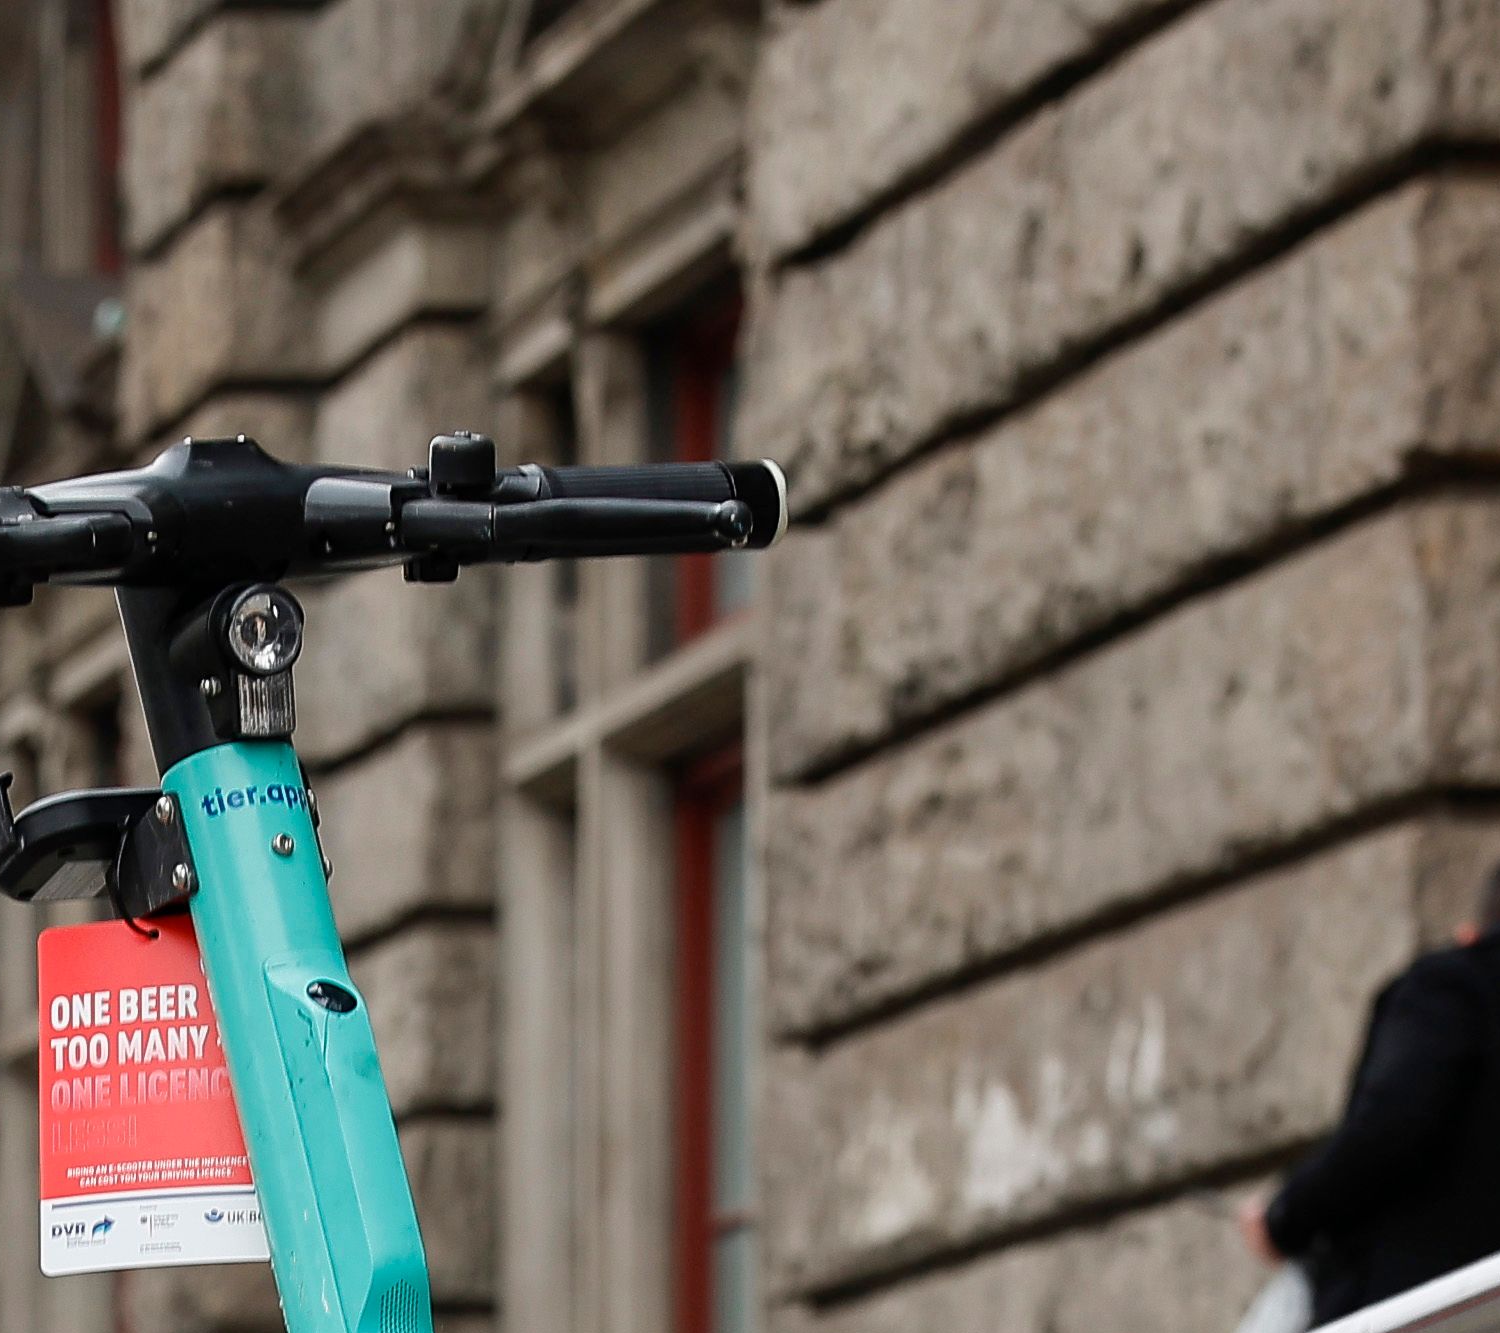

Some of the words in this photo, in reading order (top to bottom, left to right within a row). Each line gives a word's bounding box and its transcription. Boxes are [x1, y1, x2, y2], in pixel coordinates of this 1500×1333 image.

[201, 783, 307, 816] tier.app
[50, 991, 111, 1031] ONE
[119, 984, 199, 1024] BEER
[50, 1032, 110, 1072] TOO
[118, 1025, 209, 1065] MANY
[51, 1074, 111, 1113] ONE
